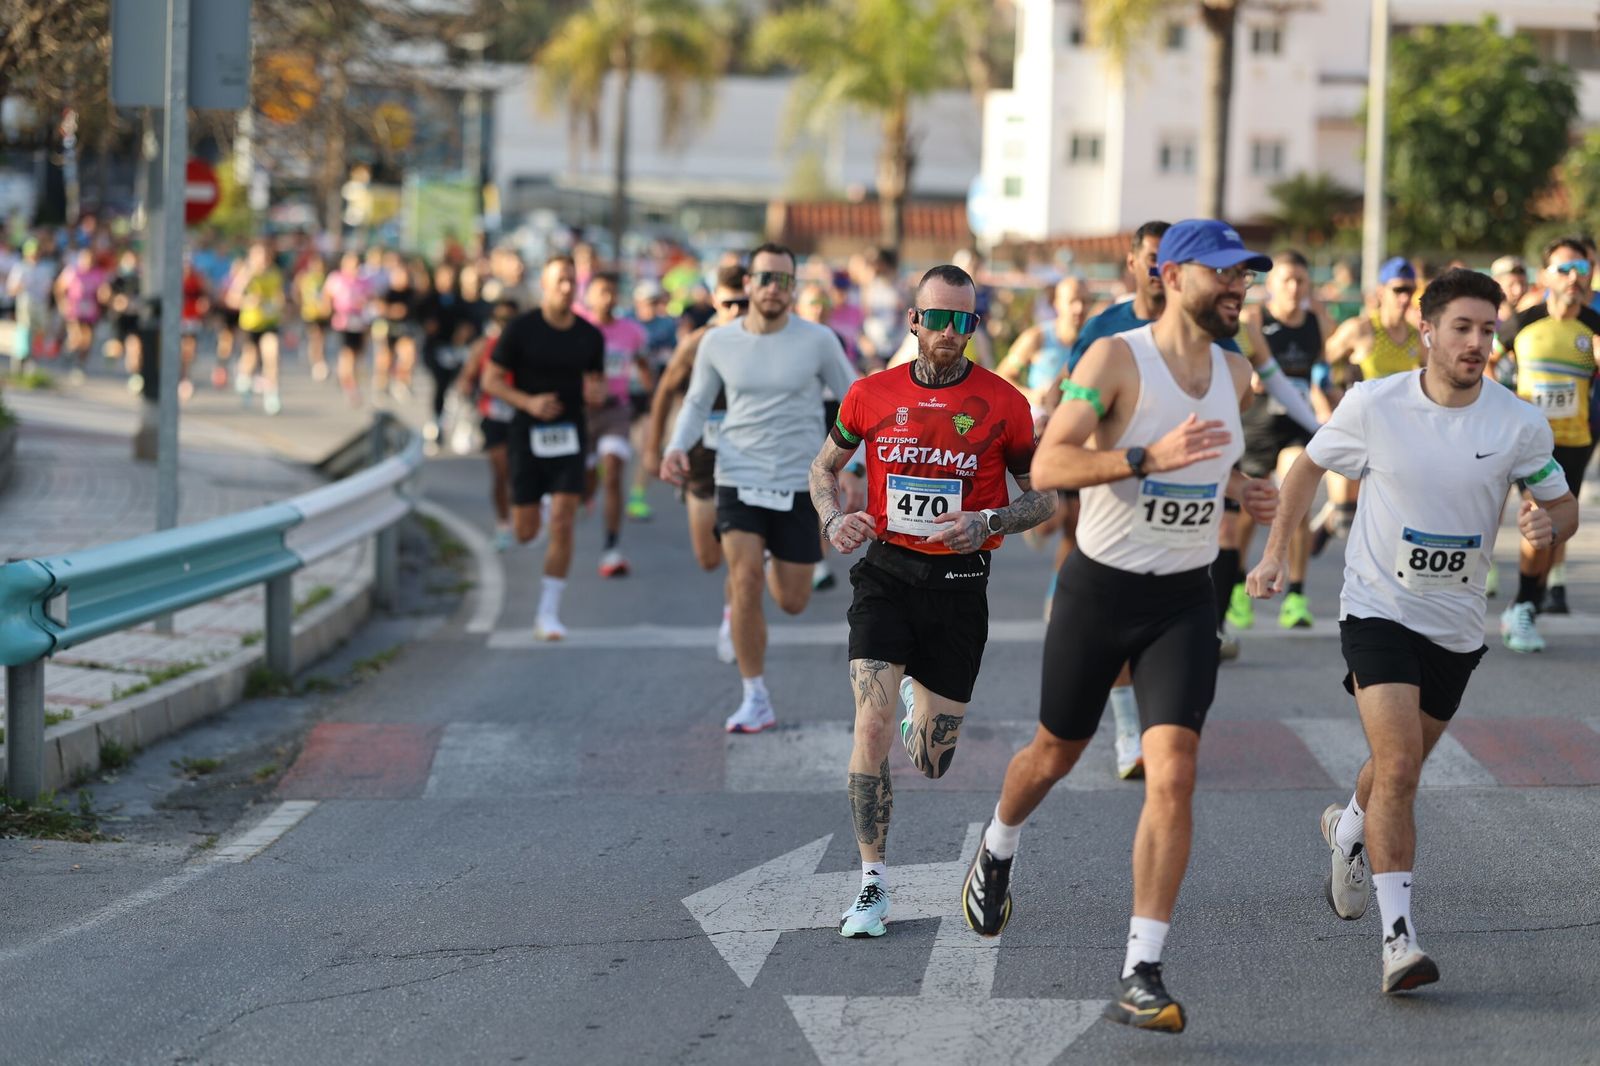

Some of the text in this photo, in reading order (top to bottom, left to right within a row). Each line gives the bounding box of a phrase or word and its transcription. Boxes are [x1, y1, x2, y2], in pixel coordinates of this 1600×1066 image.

[876, 436, 918, 444] ATLETISMO
[955, 469, 975, 477] TRAIL
[897, 493, 949, 518] 470
[1143, 499, 1214, 526] 1922
[1409, 548, 1466, 573] 808
